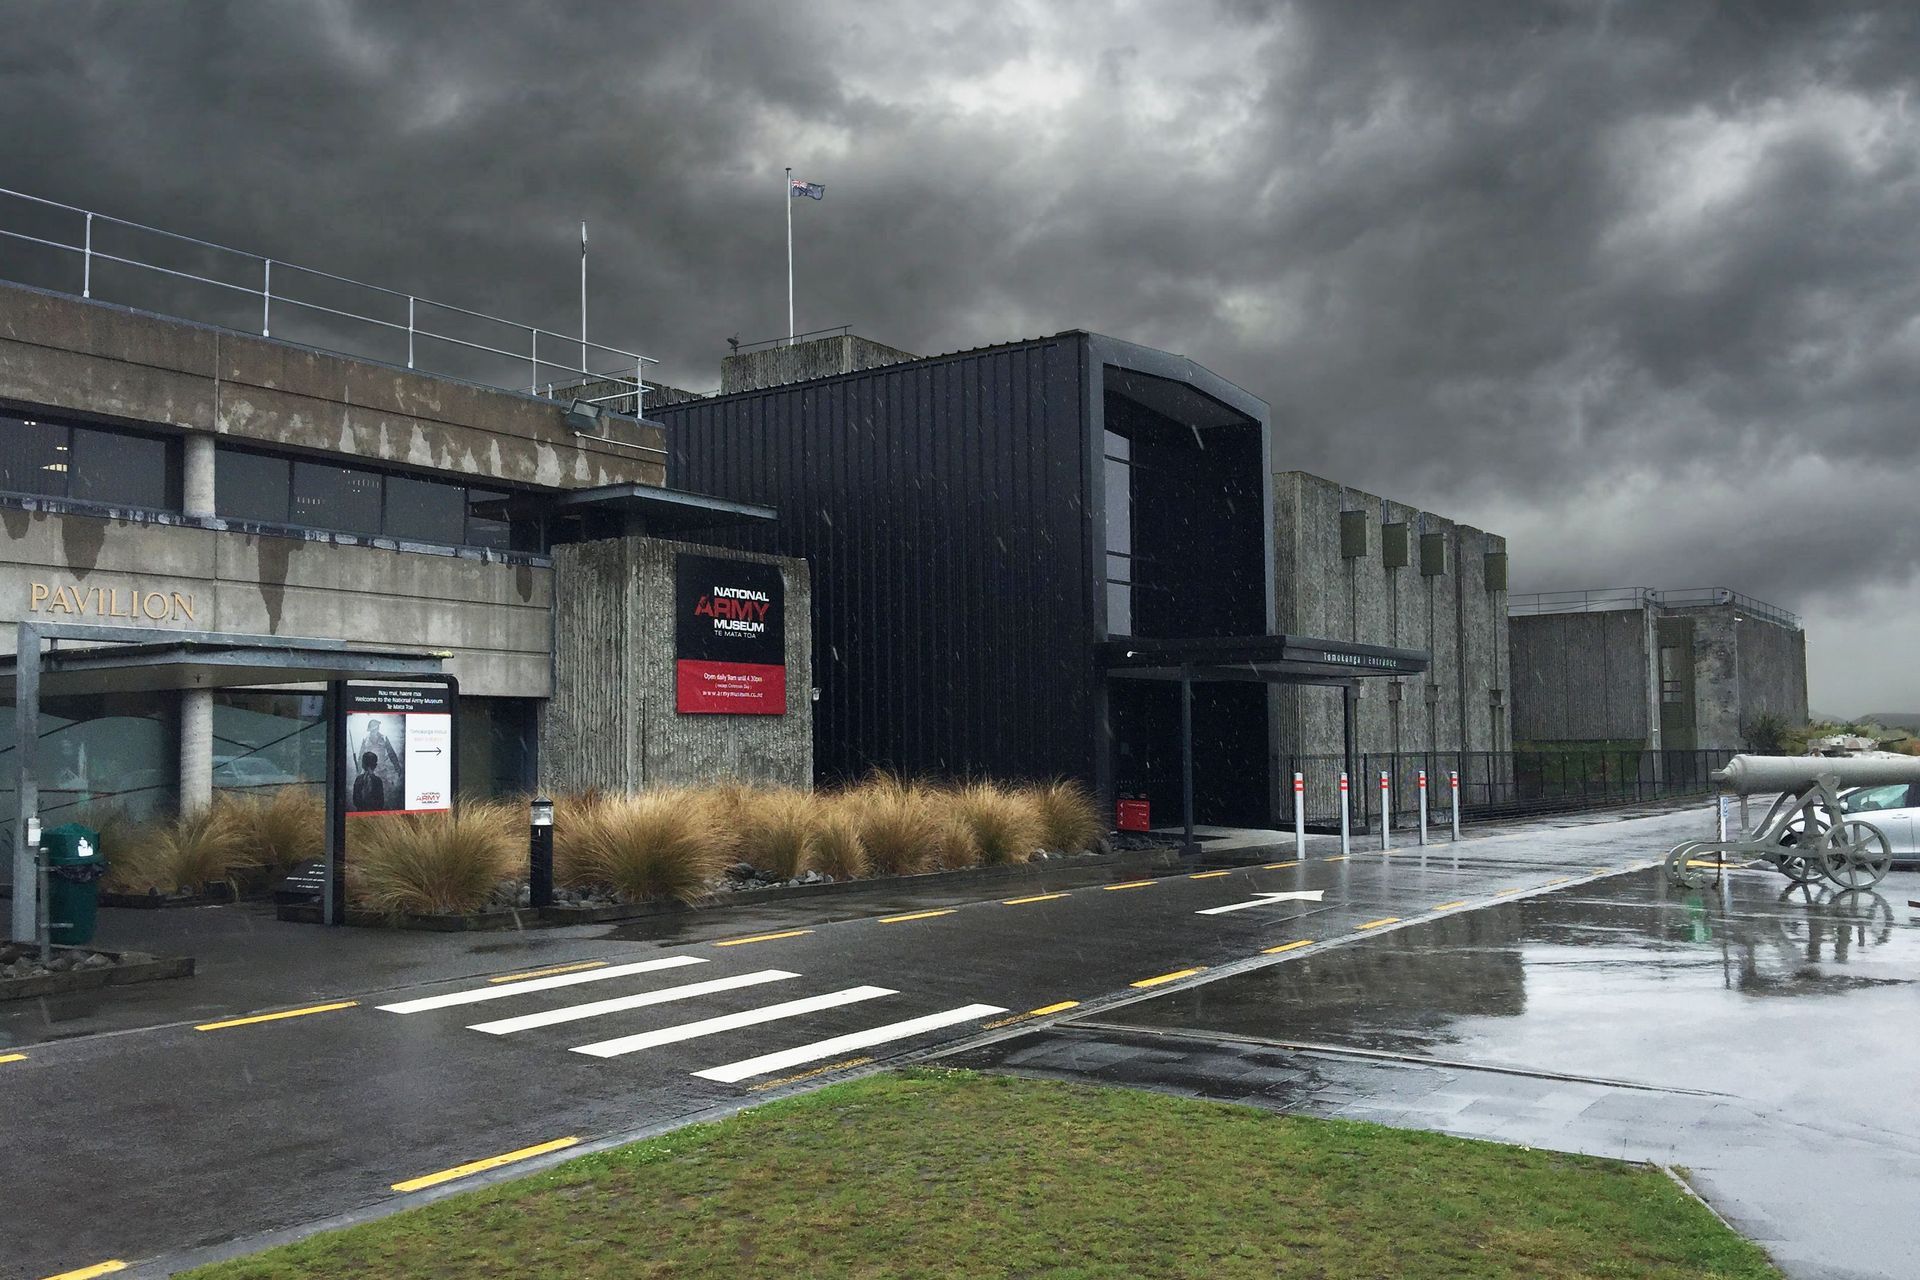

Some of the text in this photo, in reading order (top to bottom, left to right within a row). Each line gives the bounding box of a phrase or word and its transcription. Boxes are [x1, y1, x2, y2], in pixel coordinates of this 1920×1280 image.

[714, 586, 769, 602] NATIONAL
[29, 582, 195, 621] PAVILION
[694, 595, 769, 622] ARMY
[714, 619, 764, 632] MUSEUM
[1368, 656, 1397, 667] Entrance
[703, 672, 716, 681] Open
[717, 673, 727, 682] daily
